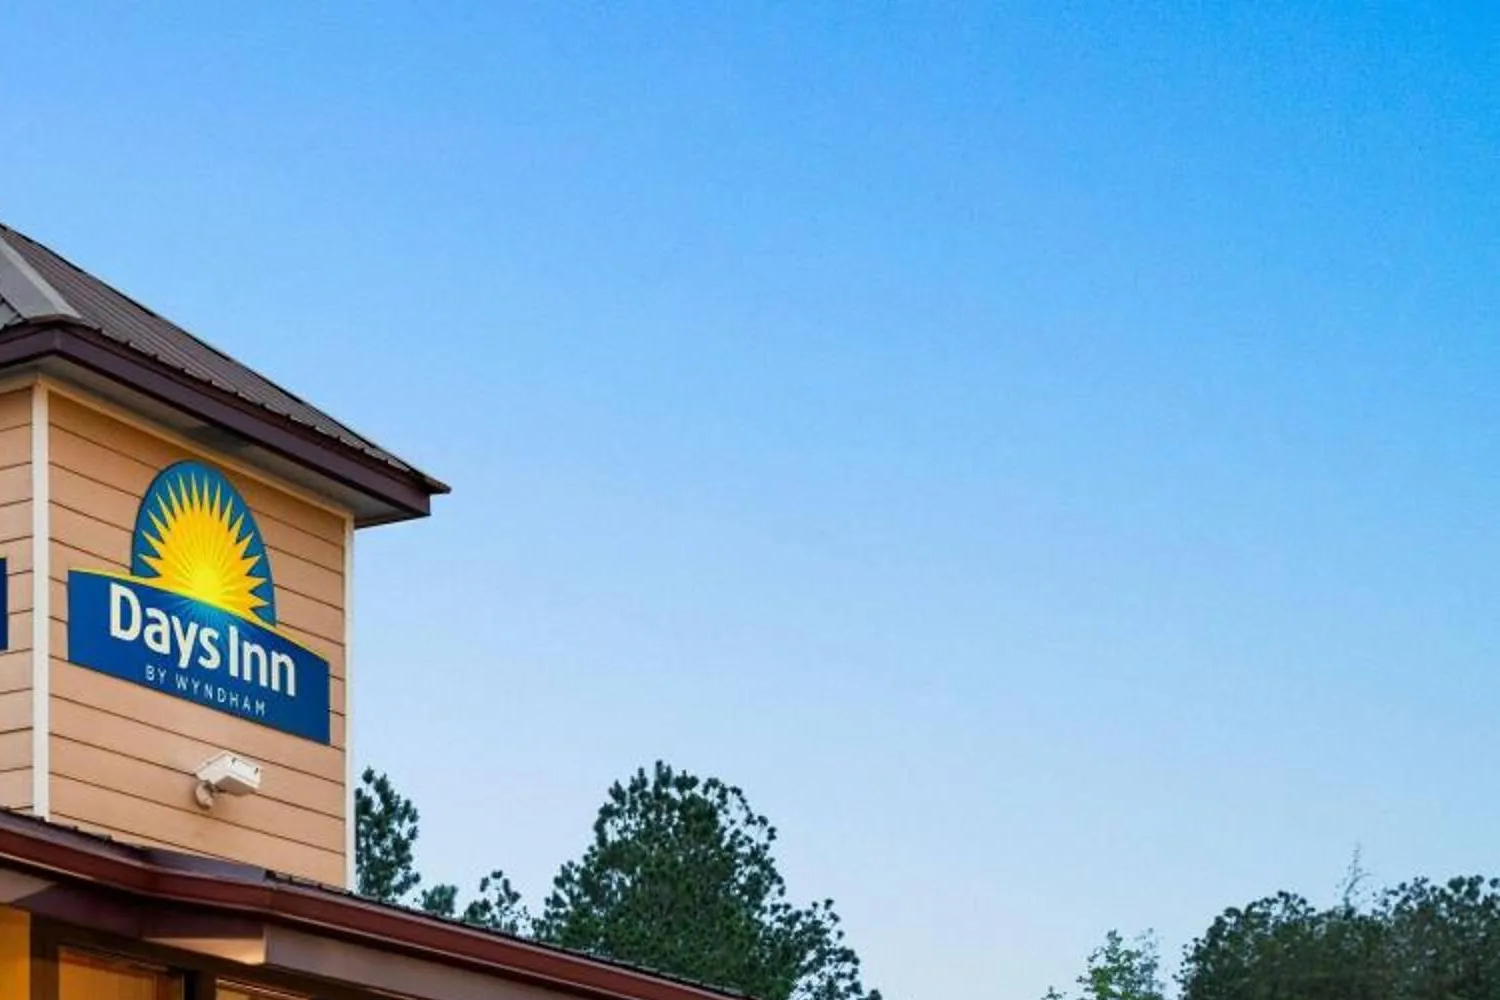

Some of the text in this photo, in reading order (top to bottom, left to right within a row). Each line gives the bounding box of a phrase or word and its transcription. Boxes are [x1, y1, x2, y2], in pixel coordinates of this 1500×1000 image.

[109, 581, 296, 697] Days Inn
[146, 664, 266, 715] BY WYNDHAM
